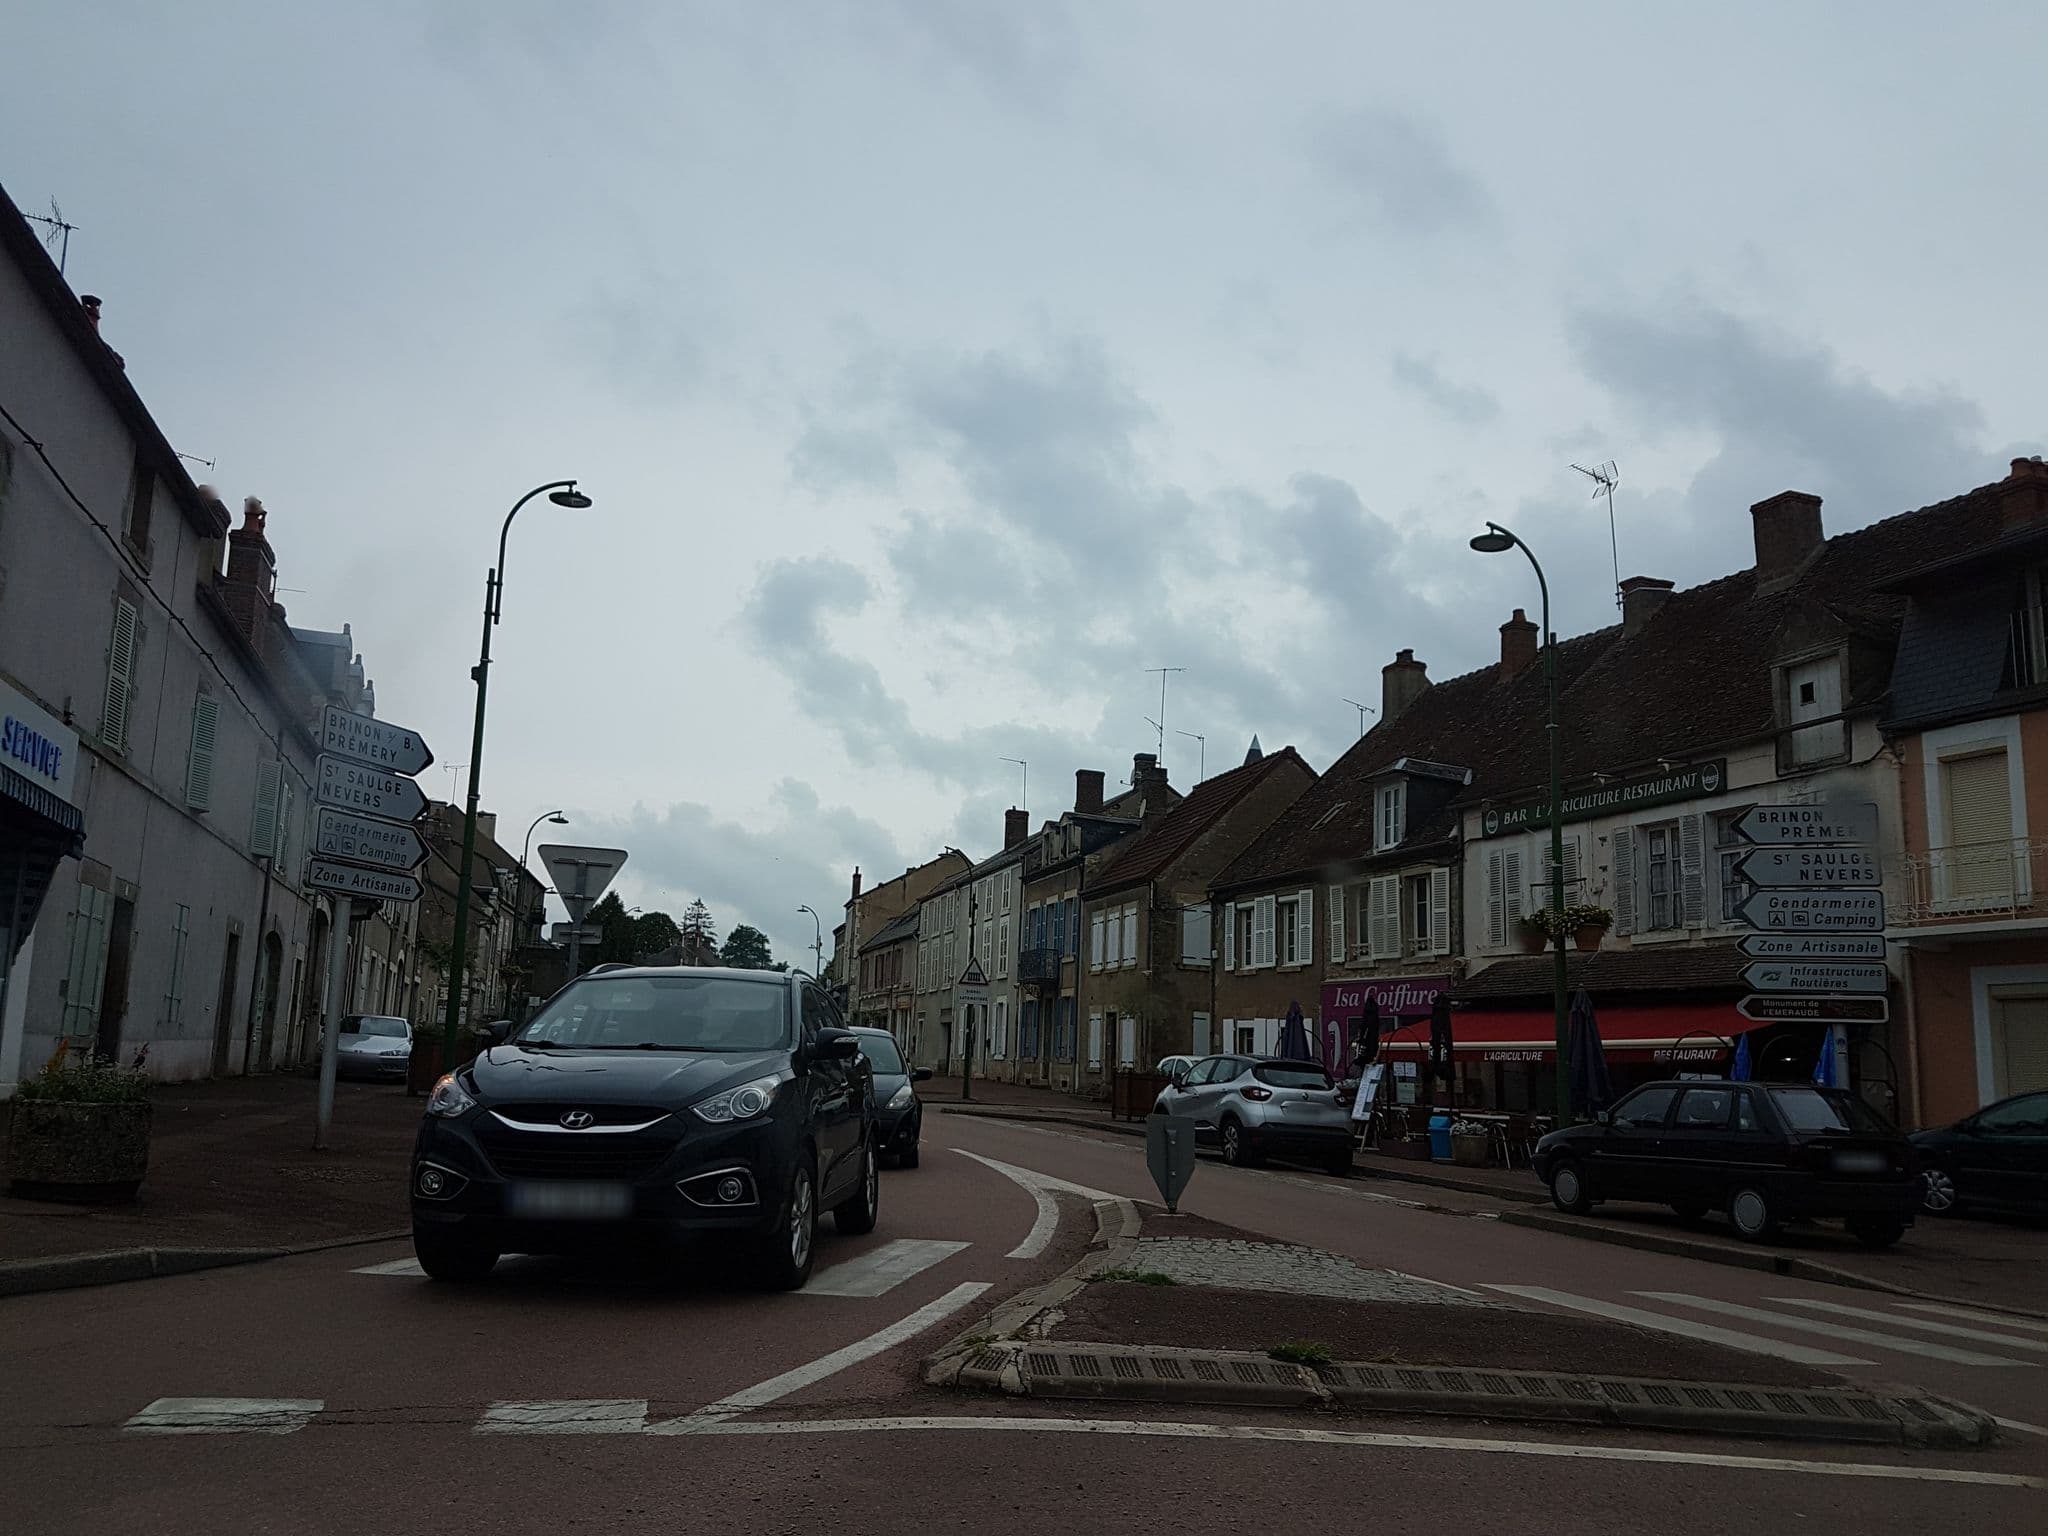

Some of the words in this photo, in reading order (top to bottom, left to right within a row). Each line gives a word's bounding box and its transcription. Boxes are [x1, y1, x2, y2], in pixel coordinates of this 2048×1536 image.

[330, 714, 381, 741] BRINON
[403, 736, 414, 751] B.
[2, 716, 62, 781] SERVICE
[328, 731, 397, 763] PRÉMERY
[347, 770, 402, 796] SAULGE
[323, 782, 381, 808] NEVERS
[1503, 809, 1528, 825] BAR
[1535, 789, 1620, 818] L'ARICULTURE
[1623, 772, 1698, 801] RESTAURANT
[1758, 810, 1823, 823] BRINON
[324, 816, 407, 846] Gendarmerie
[360, 842, 407, 867] Camping
[1801, 853, 1873, 865] SAULGE
[314, 866, 345, 884] Zone
[351, 873, 412, 896] Artisanale
[1799, 868, 1874, 881] NEVERS
[1769, 896, 1876, 909] Gendarmerie
[1814, 912, 1876, 928] Camping
[1758, 940, 1793, 952] Zone
[1801, 940, 1879, 953] Artisanale
[1789, 966, 1883, 977] Infrastructures
[1791, 977, 1849, 988] Routières
[1333, 987, 1360, 1008] Isa
[1364, 983, 1438, 1013] Coiffure
[1762, 999, 1807, 1008] Monument
[1808, 999, 1820, 1008] de
[1484, 1051, 1544, 1062] L'AGRICULTURE
[1653, 1049, 1719, 1061] RESTAURANT
